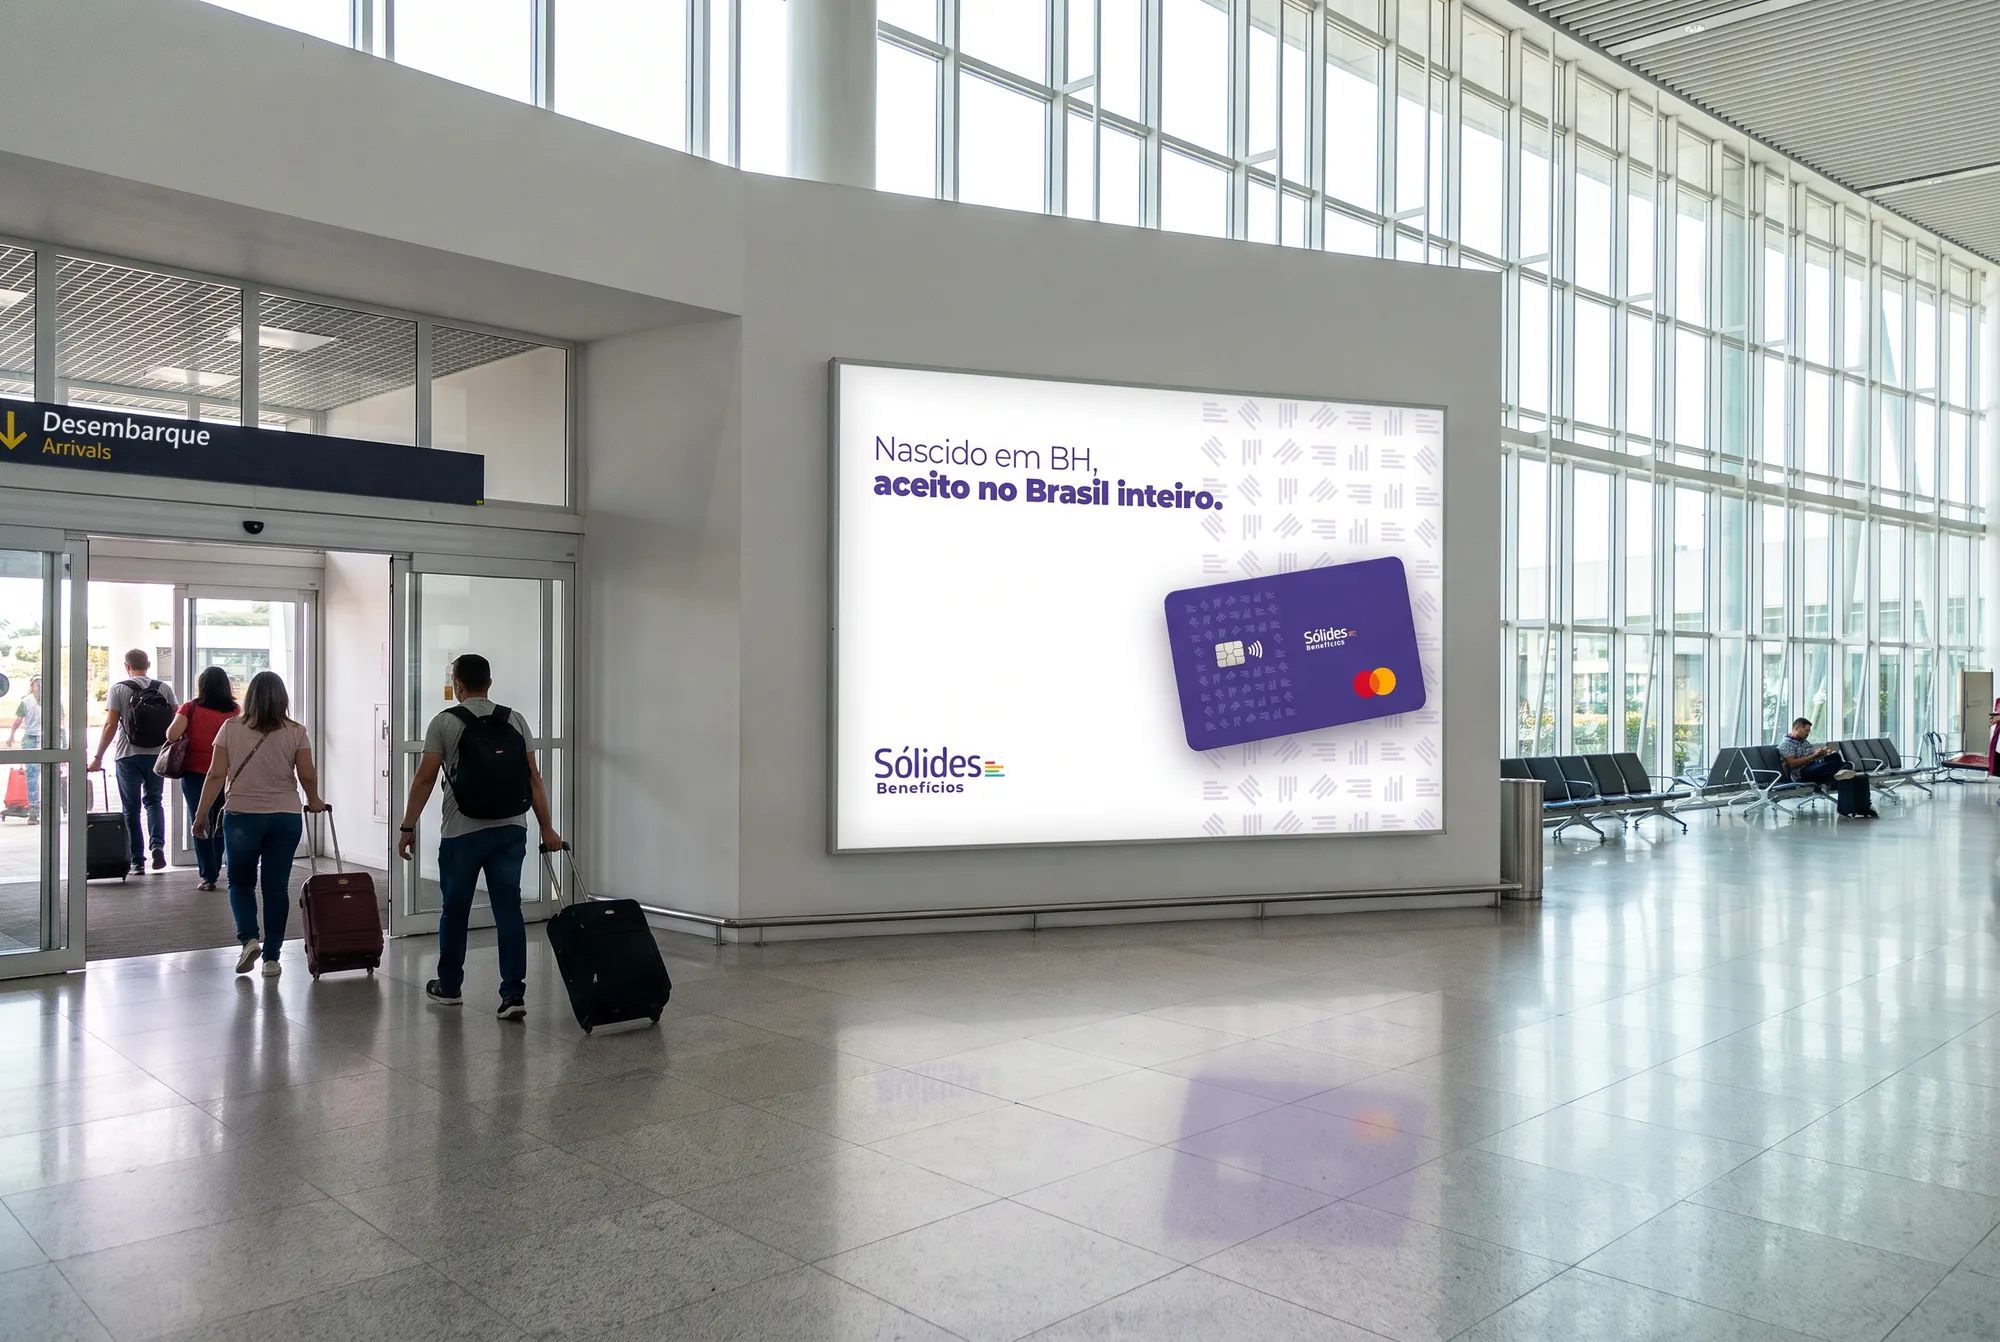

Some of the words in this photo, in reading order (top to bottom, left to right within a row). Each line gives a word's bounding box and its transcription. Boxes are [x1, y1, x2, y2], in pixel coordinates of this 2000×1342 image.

[42, 411, 211, 450] Desembarque
[41, 437, 112, 460] Arrivals
[874, 435, 988, 468] Nascido
[995, 448, 1040, 470] em
[1051, 445, 1099, 477] BH,
[873, 470, 971, 500] aceito
[978, 481, 1018, 502] no
[1026, 477, 1109, 507] Brasil
[1117, 478, 1224, 512] inteiro.
[1303, 626, 1348, 645] Sólides
[874, 745, 982, 779] Sólides
[876, 782, 965, 795] Benefícios
